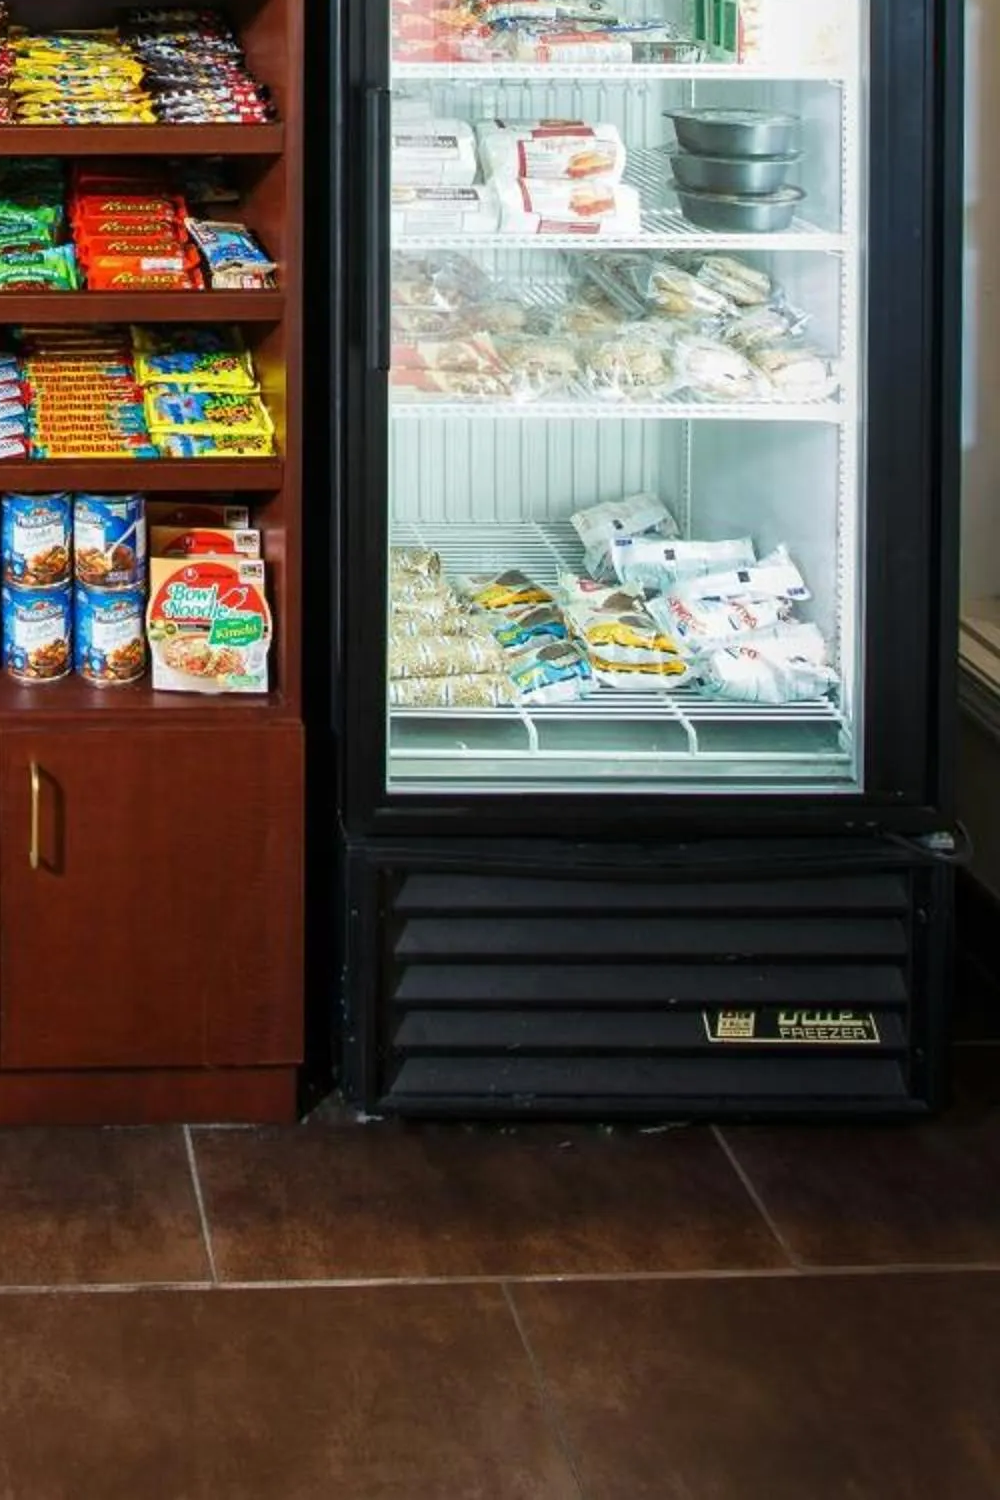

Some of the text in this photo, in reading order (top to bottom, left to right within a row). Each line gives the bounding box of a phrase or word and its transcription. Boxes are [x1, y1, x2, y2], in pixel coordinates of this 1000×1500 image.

[170, 583, 219, 602] Bowl
[163, 600, 229, 620] Noodle
[779, 1027, 867, 1039] FREEZER
